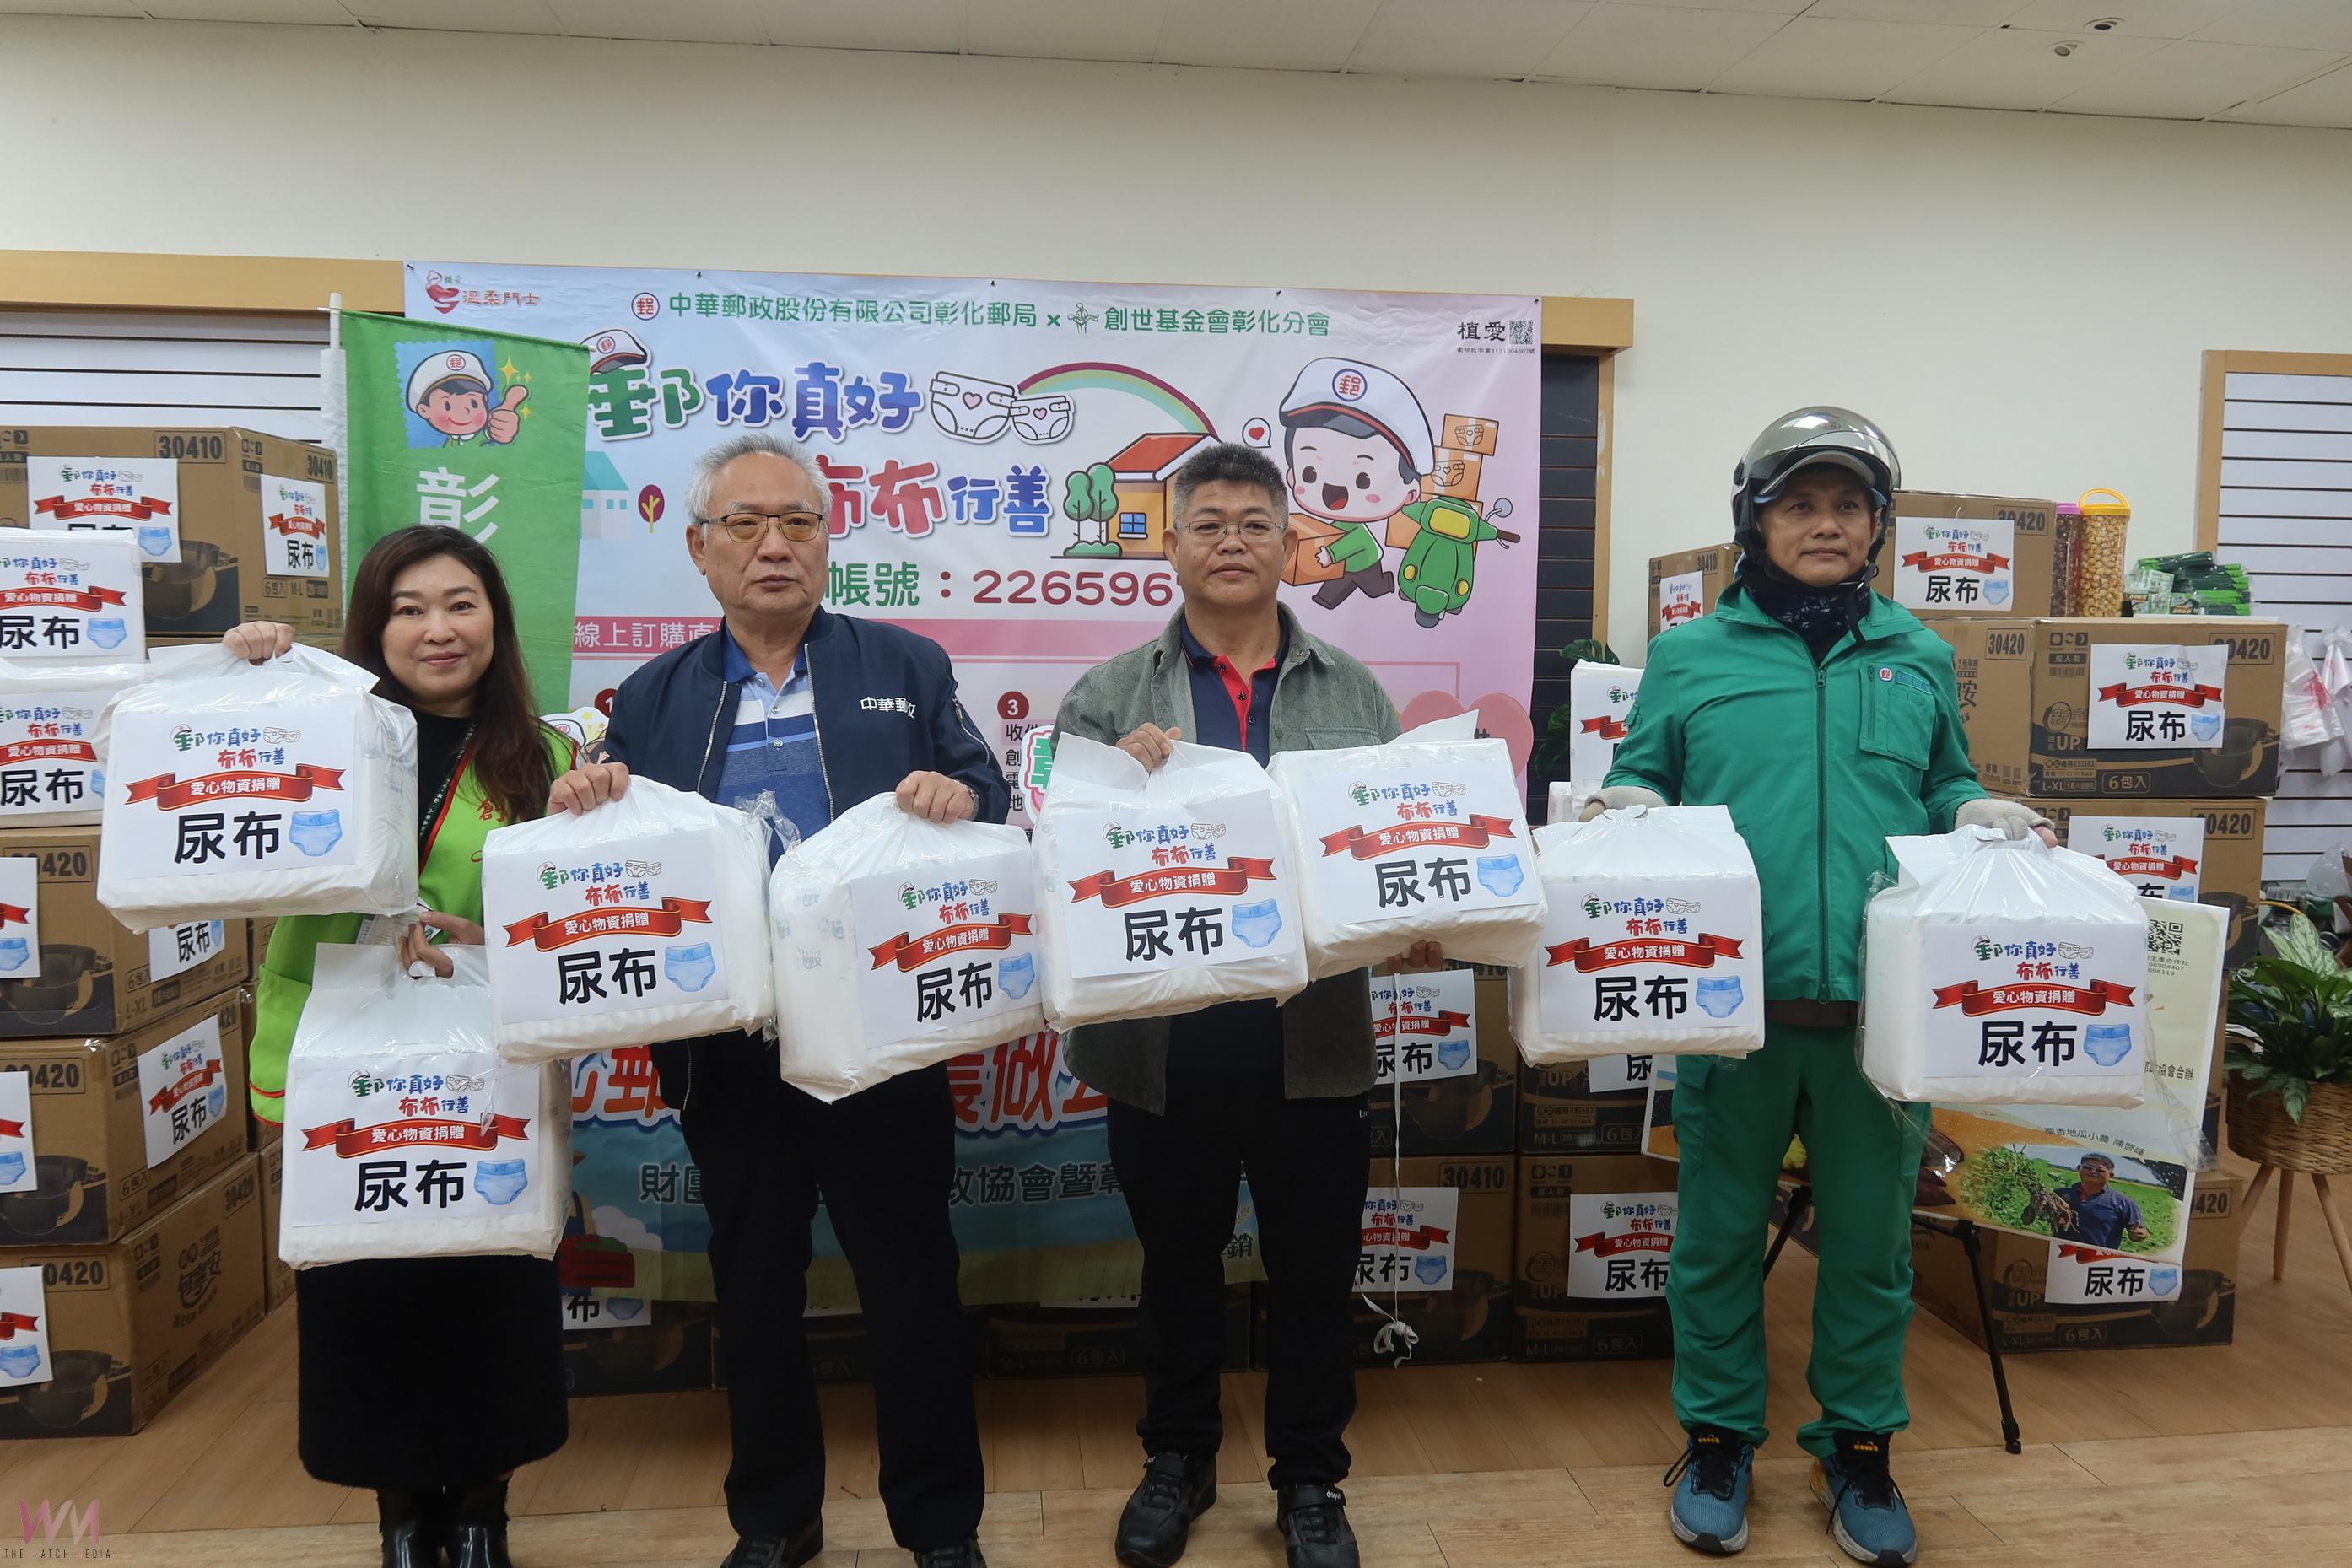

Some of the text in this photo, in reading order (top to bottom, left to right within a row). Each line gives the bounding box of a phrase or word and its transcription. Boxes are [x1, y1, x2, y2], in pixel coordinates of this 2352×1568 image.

[463, 290, 540, 306] 溫柔鬥士
[637, 298, 654, 315] 郵
[669, 292, 1037, 327] 中華郵政股份有限公司彰化郵局
[1104, 307, 1330, 336] 創世基金會彰化分會
[1457, 321, 1505, 342] 植愛
[1338, 374, 1361, 397] 郵
[589, 364, 920, 439] 郵你真好
[159, 435, 222, 459] 30410
[307, 454, 332, 479] 30410
[417, 466, 499, 541] 彰
[287, 540, 314, 569] 尿布
[1925, 575, 1980, 604] 尿布
[0, 616, 80, 649] 尿布
[575, 622, 720, 648] 線上訂購直
[1988, 633, 2025, 655] 30420
[2214, 638, 2270, 660] 0420
[1007, 699, 1019, 715] 3
[2126, 710, 2186, 741] 尿布
[175, 728, 261, 752] 郵你真好
[218, 747, 285, 768] 布布行善
[1, 768, 84, 806] 尿布
[190, 777, 280, 795] 愛心物資捐贈
[1353, 783, 1431, 806] 郵你真好
[2042, 781, 2064, 791] L-XL
[2109, 776, 2146, 789] 6包入
[1397, 800, 1458, 821] 布布行善
[2196, 813, 2250, 834] 0420
[175, 811, 282, 864] 尿布
[1108, 825, 1189, 849] 郵你真好
[1379, 827, 1459, 846] 愛心物資捐贈
[12, 852, 86, 877] 420
[1152, 843, 1216, 866] 布布行善
[542, 862, 623, 890] 郵你真好
[1130, 872, 1216, 894] 愛心物資捐贈
[1375, 857, 1471, 908] 尿布
[585, 881, 650, 906] 布布行善
[903, 881, 968, 910] 郵你真好
[939, 898, 990, 924] 布布行善
[1586, 897, 1664, 919] 郵你真好
[564, 913, 649, 935] 愛心物資捐贈
[1124, 907, 1223, 962] 尿布
[1626, 918, 1687, 937] 布布行善
[177, 921, 211, 963] 尿布
[922, 928, 989, 954] 愛心物資捐贈
[1604, 945, 1685, 960] 愛心物資捐贈
[1976, 940, 2057, 961] 郵你真好
[558, 948, 656, 1005] 尿布
[2016, 962, 2080, 980] 布布行善
[917, 962, 992, 1022] 尿布
[1594, 975, 1688, 1021] 尿布
[1992, 990, 2075, 1005] 愛心物資捐贈
[1978, 1021, 2077, 1067] 尿布
[1376, 1043, 1432, 1077] 尿布
[5, 1064, 79, 1088] 420
[352, 1074, 444, 1097] 郵你真好
[398, 1096, 469, 1117] 布布行善
[171, 1096, 207, 1145] 尿布
[371, 1125, 465, 1143] 愛心物資捐贈
[355, 1160, 467, 1212] 尿布
[1443, 1166, 1505, 1188] 30410
[2193, 1193, 2228, 1215] 420
[30, 1259, 104, 1286] 0420
[1355, 1253, 1411, 1285] 尿布
[1605, 1259, 1670, 1291] 尿布
[2084, 1266, 2145, 1297] 尿布
